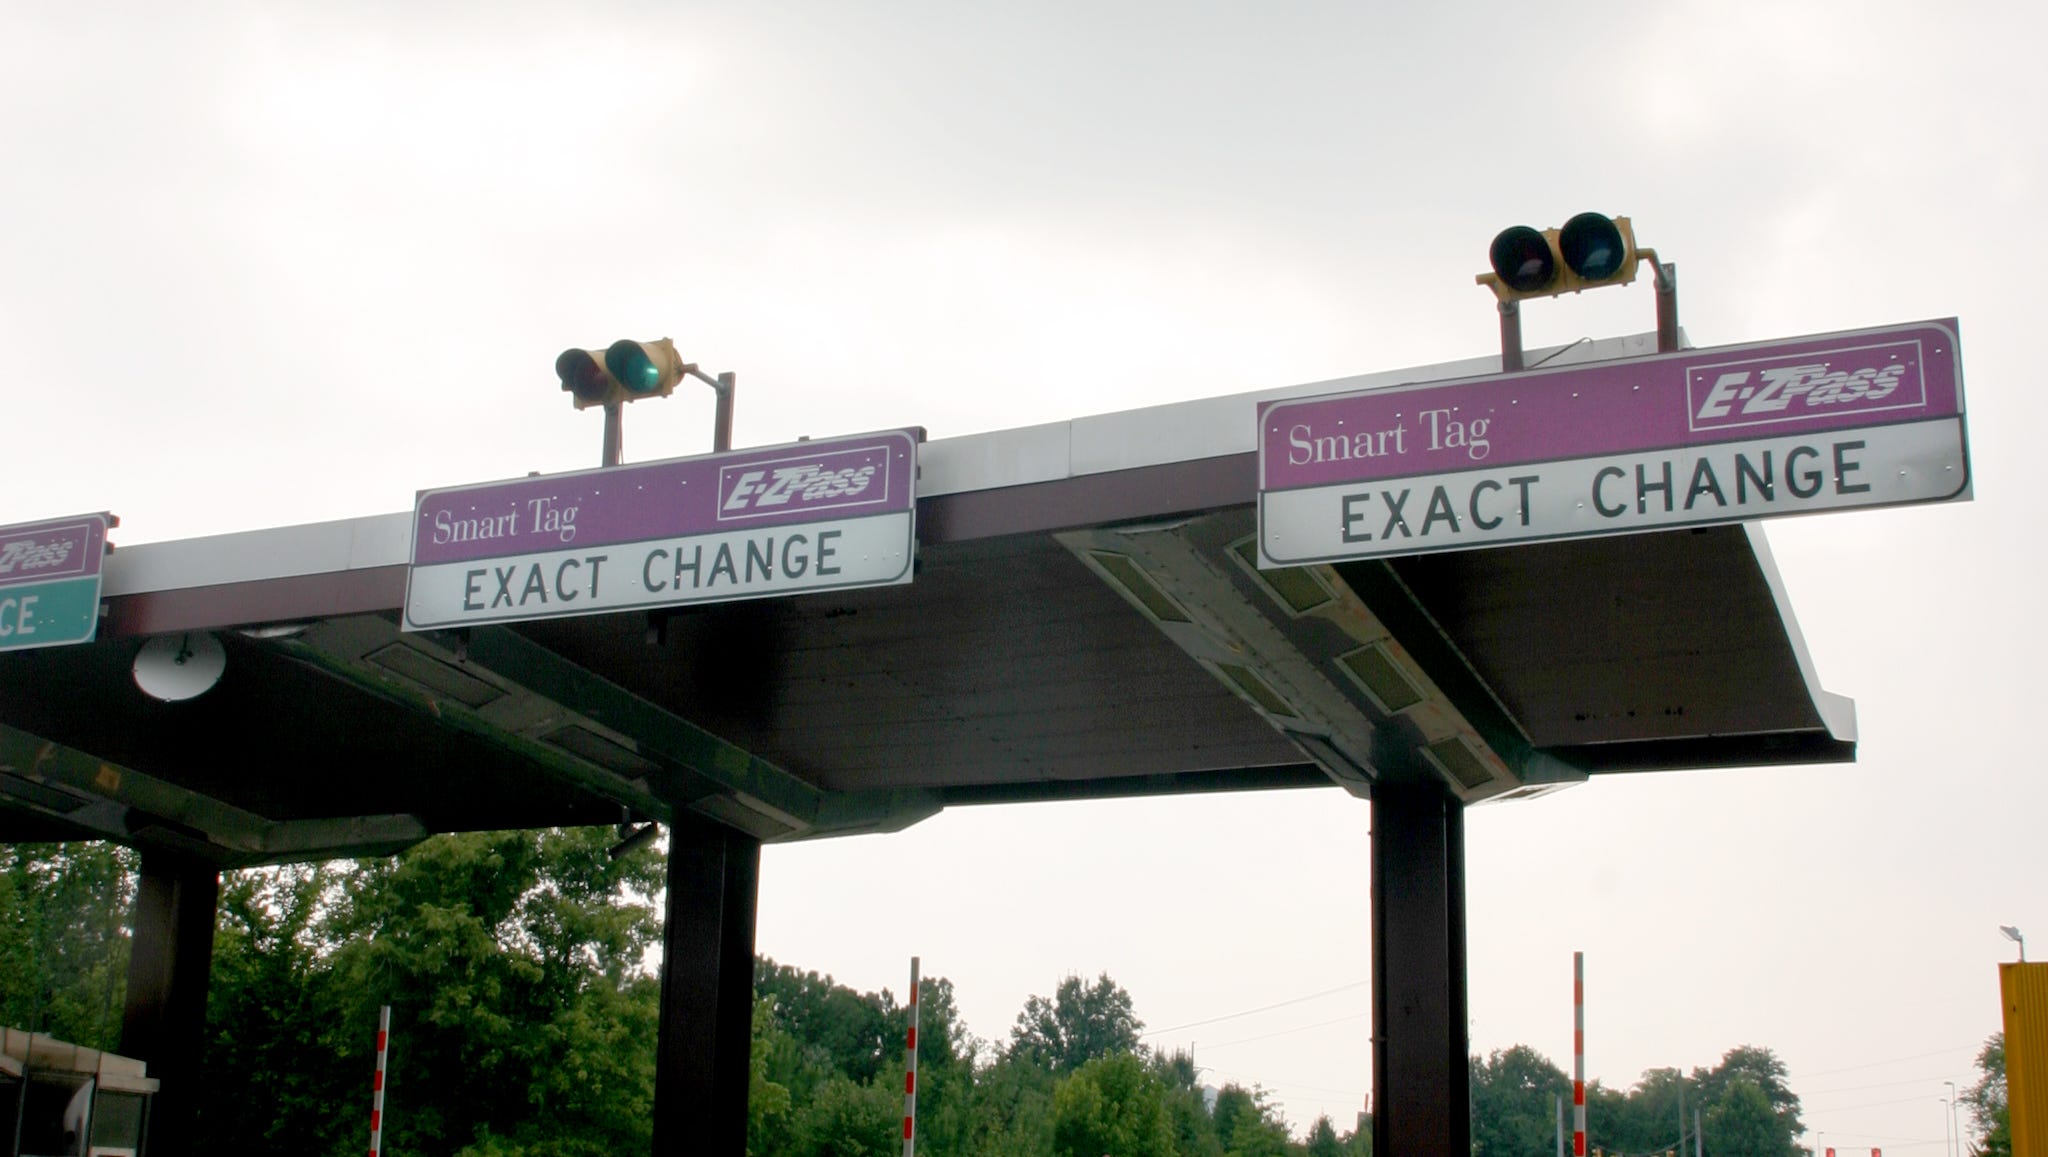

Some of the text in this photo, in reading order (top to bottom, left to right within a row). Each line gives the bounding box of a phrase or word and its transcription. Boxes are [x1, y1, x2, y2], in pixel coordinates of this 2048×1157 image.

[1288, 409, 1491, 465] Smart Tag
[432, 498, 579, 545] Smart Tag
[1341, 440, 1871, 543] EXACT CHANGE
[463, 530, 843, 612] EXACT CHANGE
